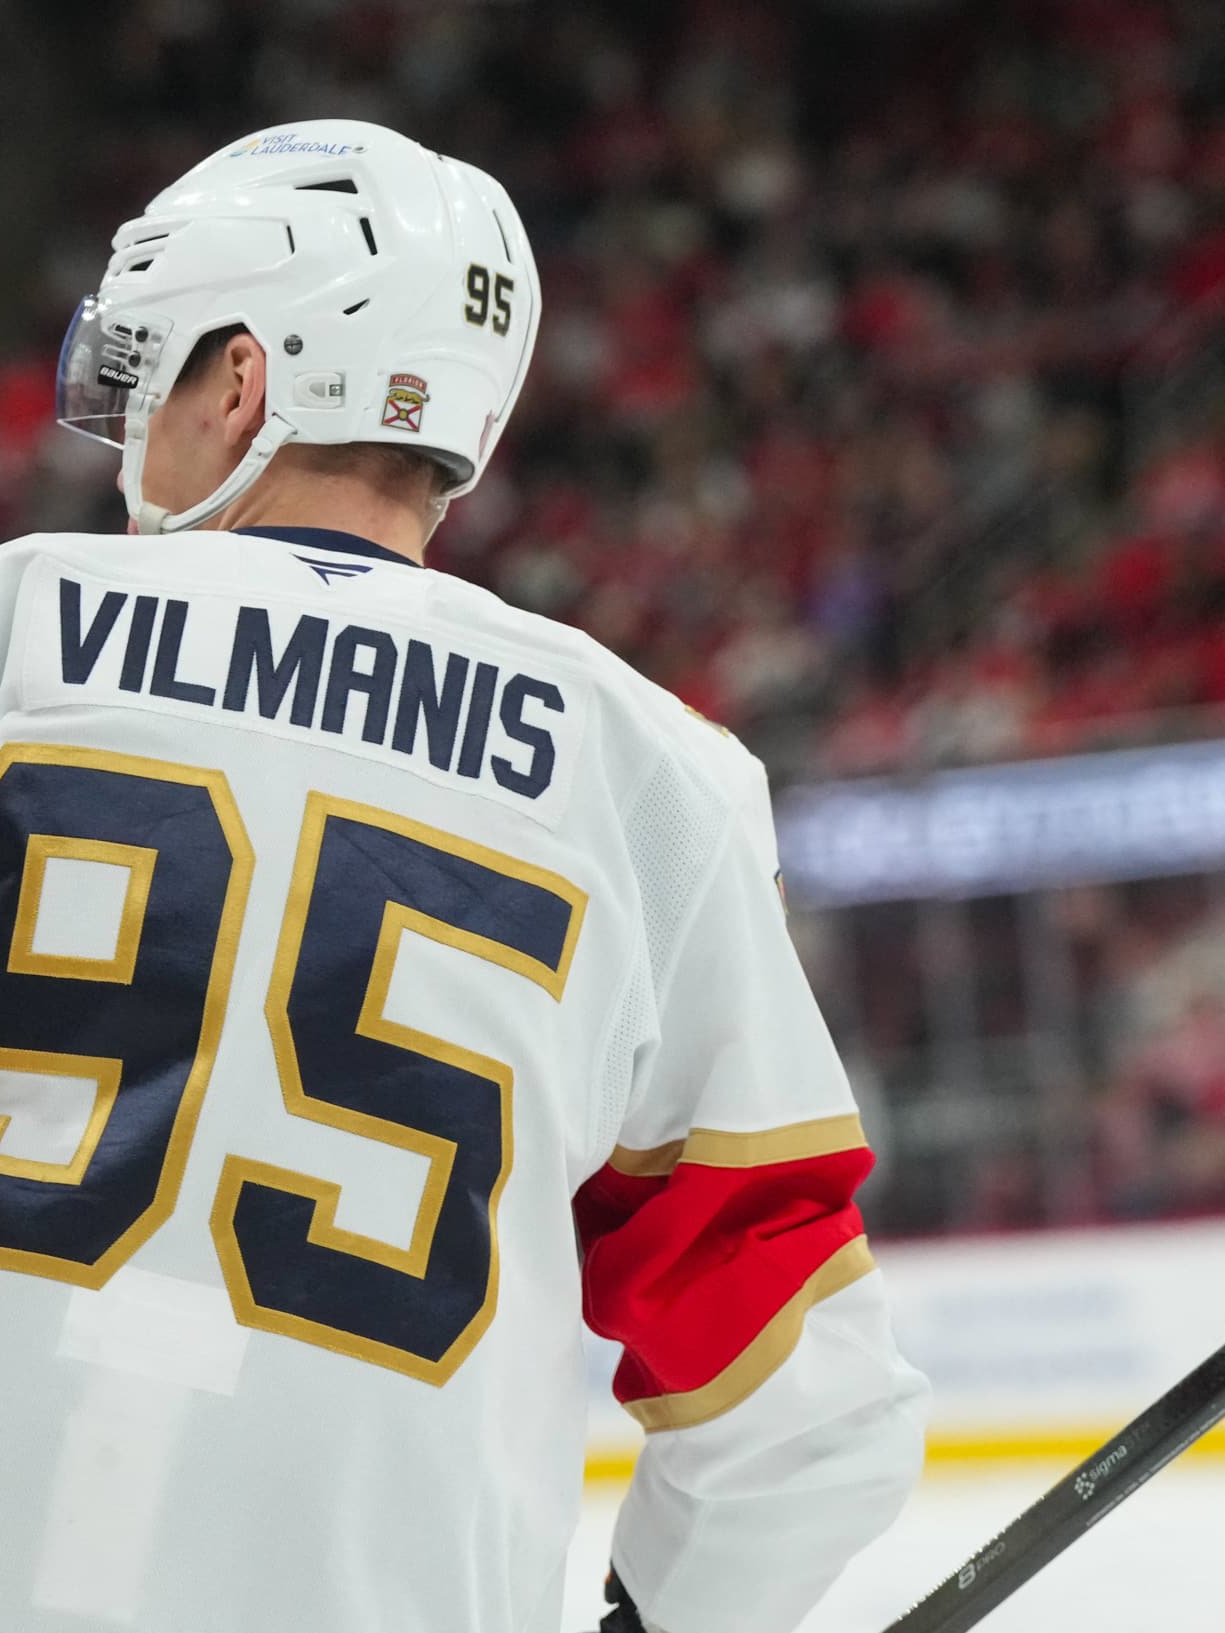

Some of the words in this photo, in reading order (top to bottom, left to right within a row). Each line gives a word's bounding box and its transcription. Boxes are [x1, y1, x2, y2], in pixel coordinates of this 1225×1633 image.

[262, 134, 297, 144] VISIT
[250, 142, 351, 156] LAUDERDALE
[463, 262, 515, 337] 95
[99, 366, 137, 385] BAUER
[58, 578, 566, 800] VILMANIS
